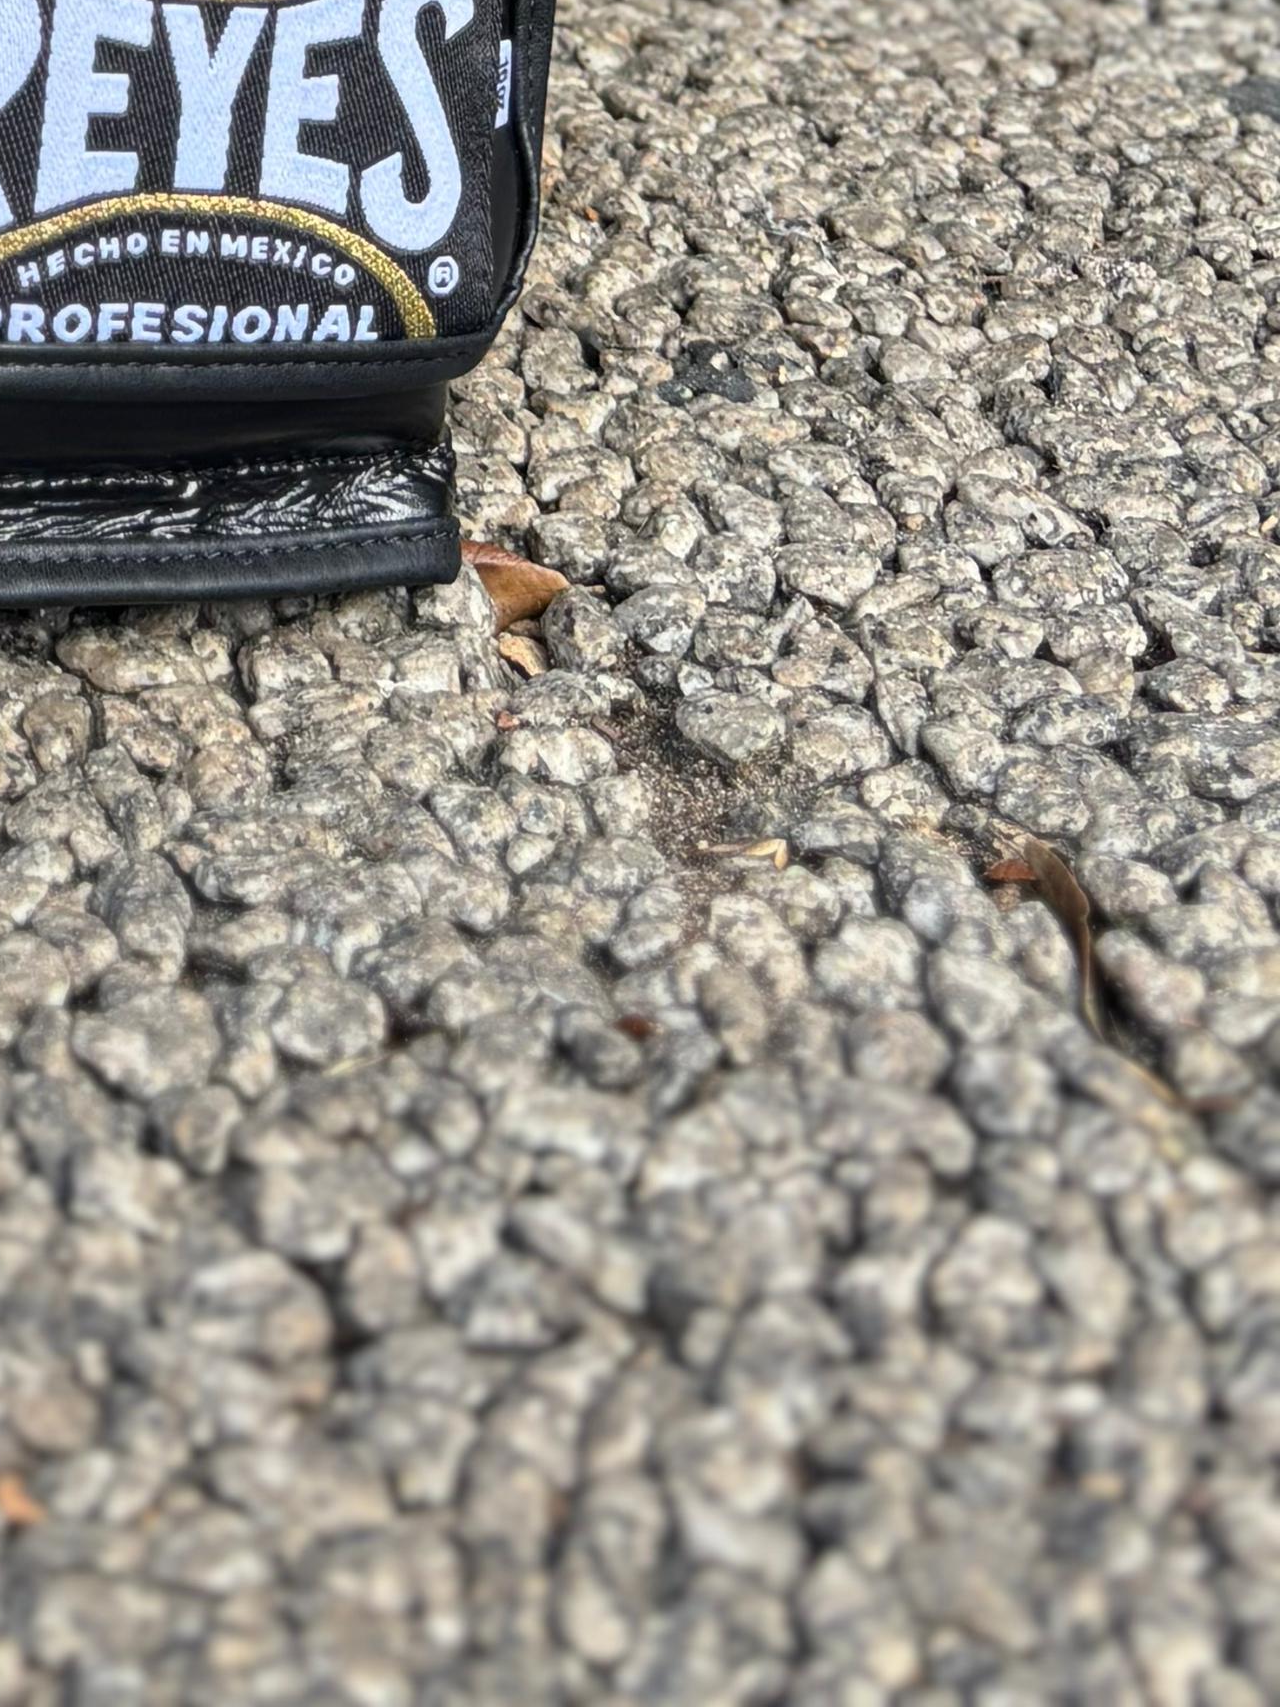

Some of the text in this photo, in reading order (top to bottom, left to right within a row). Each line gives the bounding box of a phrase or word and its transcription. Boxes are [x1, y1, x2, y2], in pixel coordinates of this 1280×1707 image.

[17, 228, 357, 288] HECHO EN MEXICO
